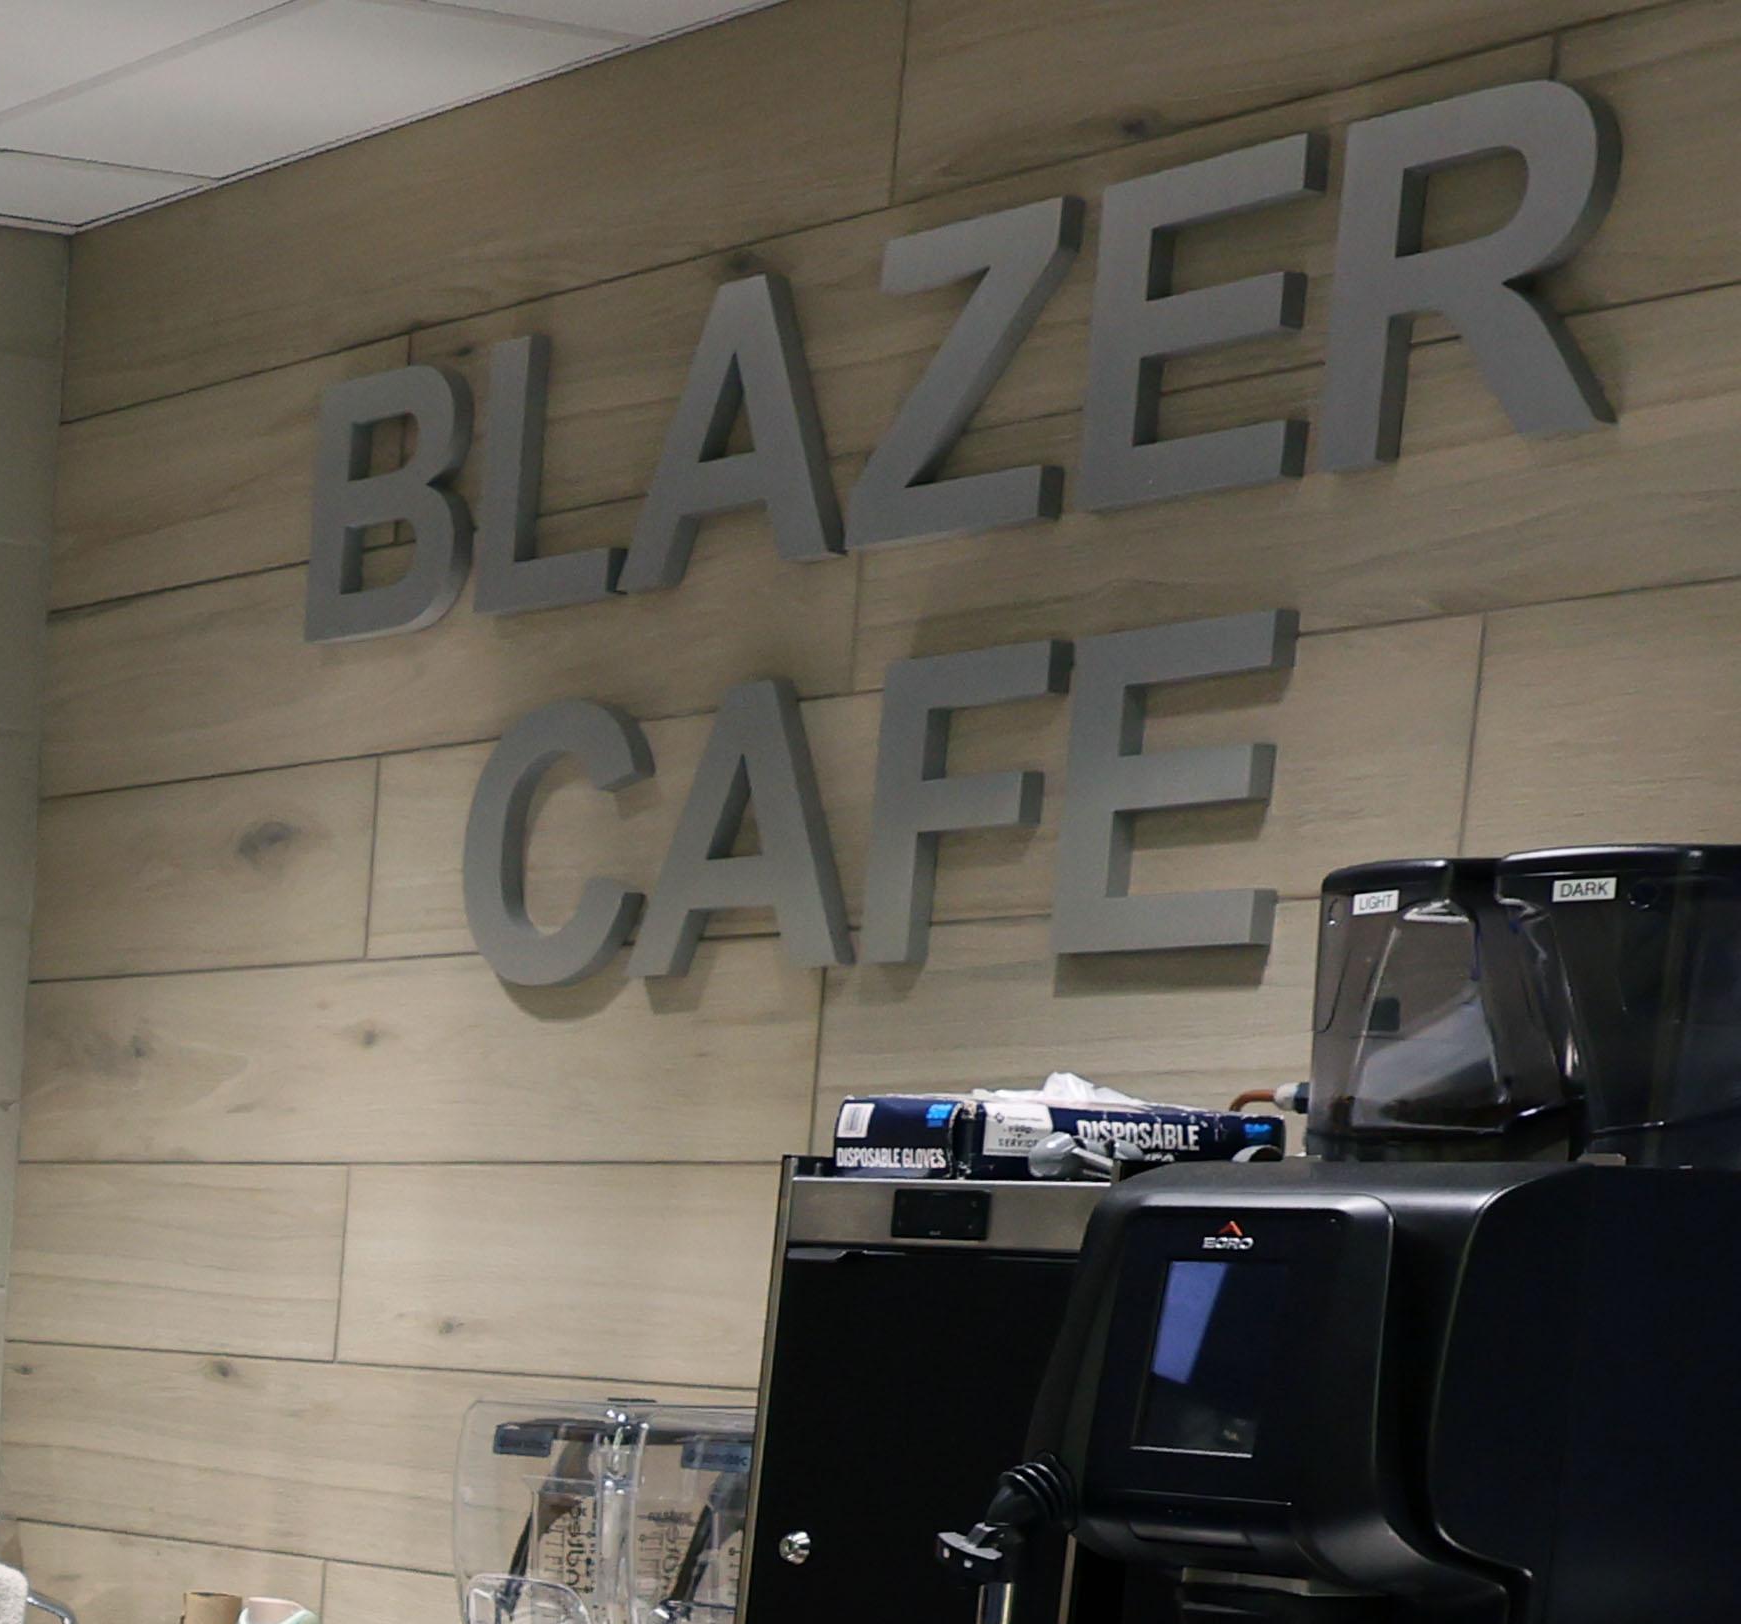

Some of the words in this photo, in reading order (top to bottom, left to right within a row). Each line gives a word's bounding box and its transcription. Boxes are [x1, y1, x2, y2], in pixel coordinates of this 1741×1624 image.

[305, 79, 1623, 642] BLAZER
[461, 607, 1299, 986] CAFE
[1559, 882, 1610, 899] DARK
[1358, 894, 1394, 911] LIGHT
[1076, 1119, 1201, 1151] DISPOSABLE
[836, 1146, 901, 1168] DISPOSABLE
[902, 1147, 947, 1168] GLOVES
